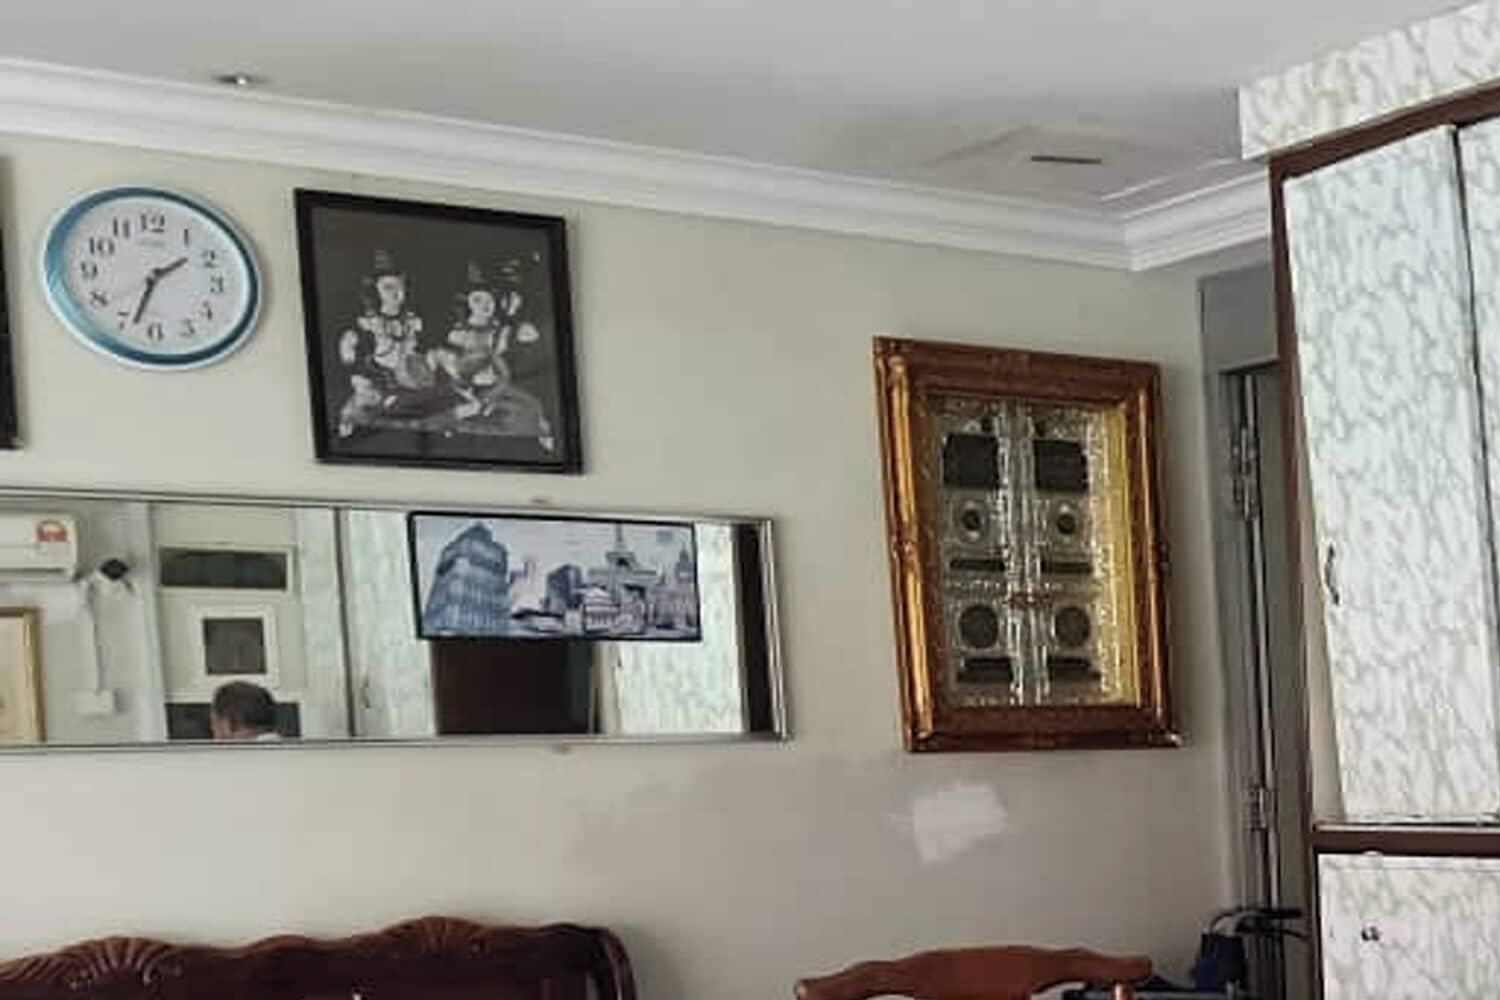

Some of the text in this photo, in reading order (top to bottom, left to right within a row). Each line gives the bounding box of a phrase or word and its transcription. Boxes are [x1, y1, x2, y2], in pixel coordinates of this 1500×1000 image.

[113, 216, 130, 238] 11
[139, 214, 165, 233] 12
[89, 236, 115, 255] 10
[203, 250, 216, 268] 2
[81, 261, 98, 280] 9
[209, 274, 224, 294] 3
[89, 291, 108, 311] 8
[201, 301, 214, 320] 4
[117, 310, 131, 331] 7
[181, 318, 196, 339] 5
[147, 322, 165, 342] 6
